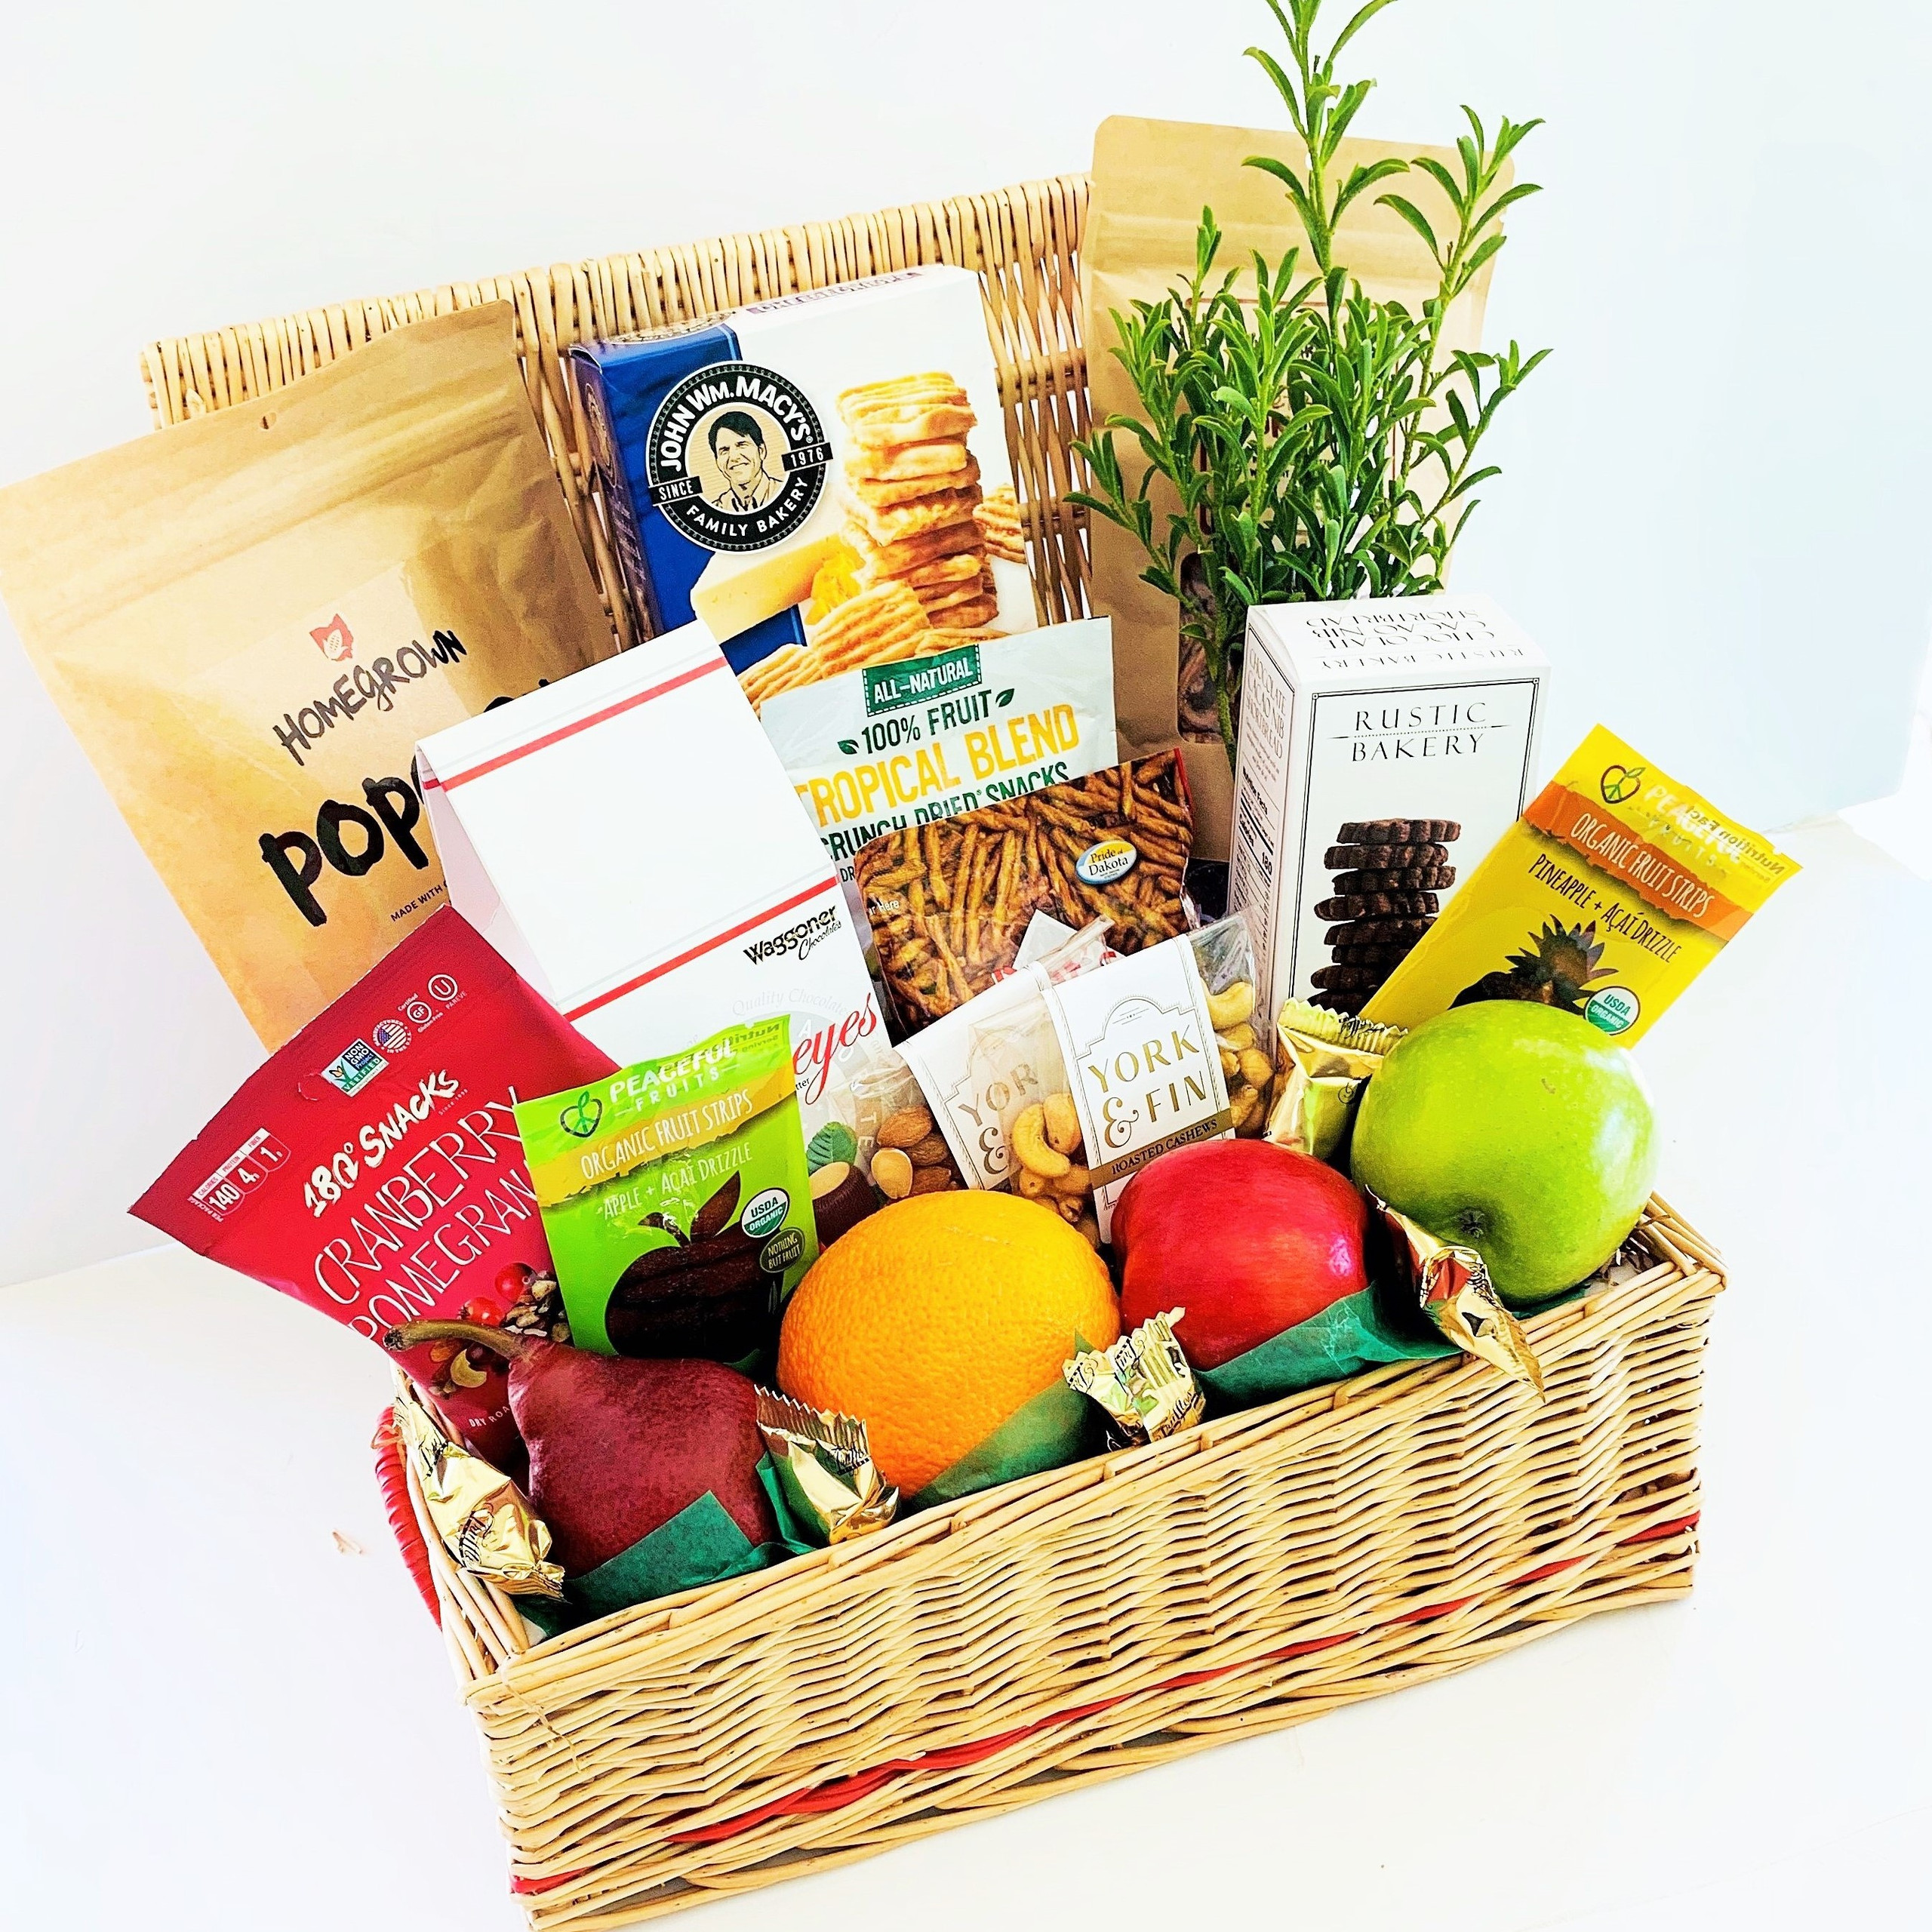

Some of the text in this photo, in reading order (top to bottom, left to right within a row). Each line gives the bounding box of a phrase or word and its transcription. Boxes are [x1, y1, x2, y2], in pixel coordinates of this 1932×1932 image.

[660, 405, 695, 472] JOHN
[735, 375, 811, 441] MACY'S
[659, 448, 823, 500] SINCE 1976
[686, 505, 748, 537] FAMILY
[756, 477, 808, 534] BAKERY
[1306, 610, 1478, 628] SHORTBREAD
[1312, 620, 1487, 638] CACAO NIB
[1322, 647, 1524, 669] RUSTIC BAKERY
[1324, 631, 1495, 650] CHOCOLATE
[272, 630, 467, 766] HOMEGROWN
[873, 657, 974, 704] ALL-NATURAL
[1247, 669, 1271, 718] CACAO
[1249, 648, 1286, 716] CHOCOLATE
[861, 688, 992, 755] 100% FRUIT
[1355, 702, 1487, 731] RUSTIC
[964, 703, 1080, 782] BLEND
[1352, 733, 1484, 762] BAKERY
[986, 761, 1070, 801] SNACKS
[258, 755, 429, 928] POP
[1091, 848, 1115, 863] Pride
[1088, 857, 1128, 875] Dakota
[1571, 812, 1715, 918] ORGANIC FRUIT STRIPS
[390, 900, 418, 921] MADE
[417, 884, 443, 904] WITH
[1528, 854, 1596, 909] PINEAPPLE
[1594, 901, 1602, 910] +
[1630, 918, 1681, 964] DRIZZLE
[743, 906, 836, 965] Waggoner
[798, 920, 842, 961] Chocolates
[413, 1005, 426, 1019] GF
[732, 992, 784, 1017] Quality
[1591, 1004, 1624, 1029] ORGANIC
[1604, 994, 1631, 1016] USDA
[344, 1043, 365, 1060] NON
[350, 1048, 369, 1065] GMO
[792, 992, 876, 1105] eyes
[1088, 1024, 1200, 1094] YORK
[344, 1057, 381, 1091] VERIFIED
[609, 1039, 737, 1103] PEACEFUL
[636, 1067, 719, 1112] FRUITS
[795, 1078, 811, 1091] tter
[958, 1063, 1039, 1128] YOR
[1103, 1070, 1207, 1149] & FIN
[580, 1088, 753, 1180] ORGANIC FRUIT STRIPS
[1112, 1119, 1217, 1175] ROASTED CASHEWS
[223, 1155, 240, 1173] PROTEIN
[604, 1187, 642, 1220] APPLE
[698, 1142, 752, 1181] DRIZZLE
[198, 1177, 218, 1196] CALORIES
[208, 1183, 240, 1211] 140
[314, 1086, 522, 1304] CRANBERRY
[749, 1207, 783, 1231] ORGANIC
[751, 1197, 778, 1218] USDA
[348, 1160, 538, 1340] POMEGRAN
[768, 1232, 798, 1257] NOTHING
[768, 1244, 800, 1269] BUT FRUIT
[469, 1418, 487, 1427] DRY
